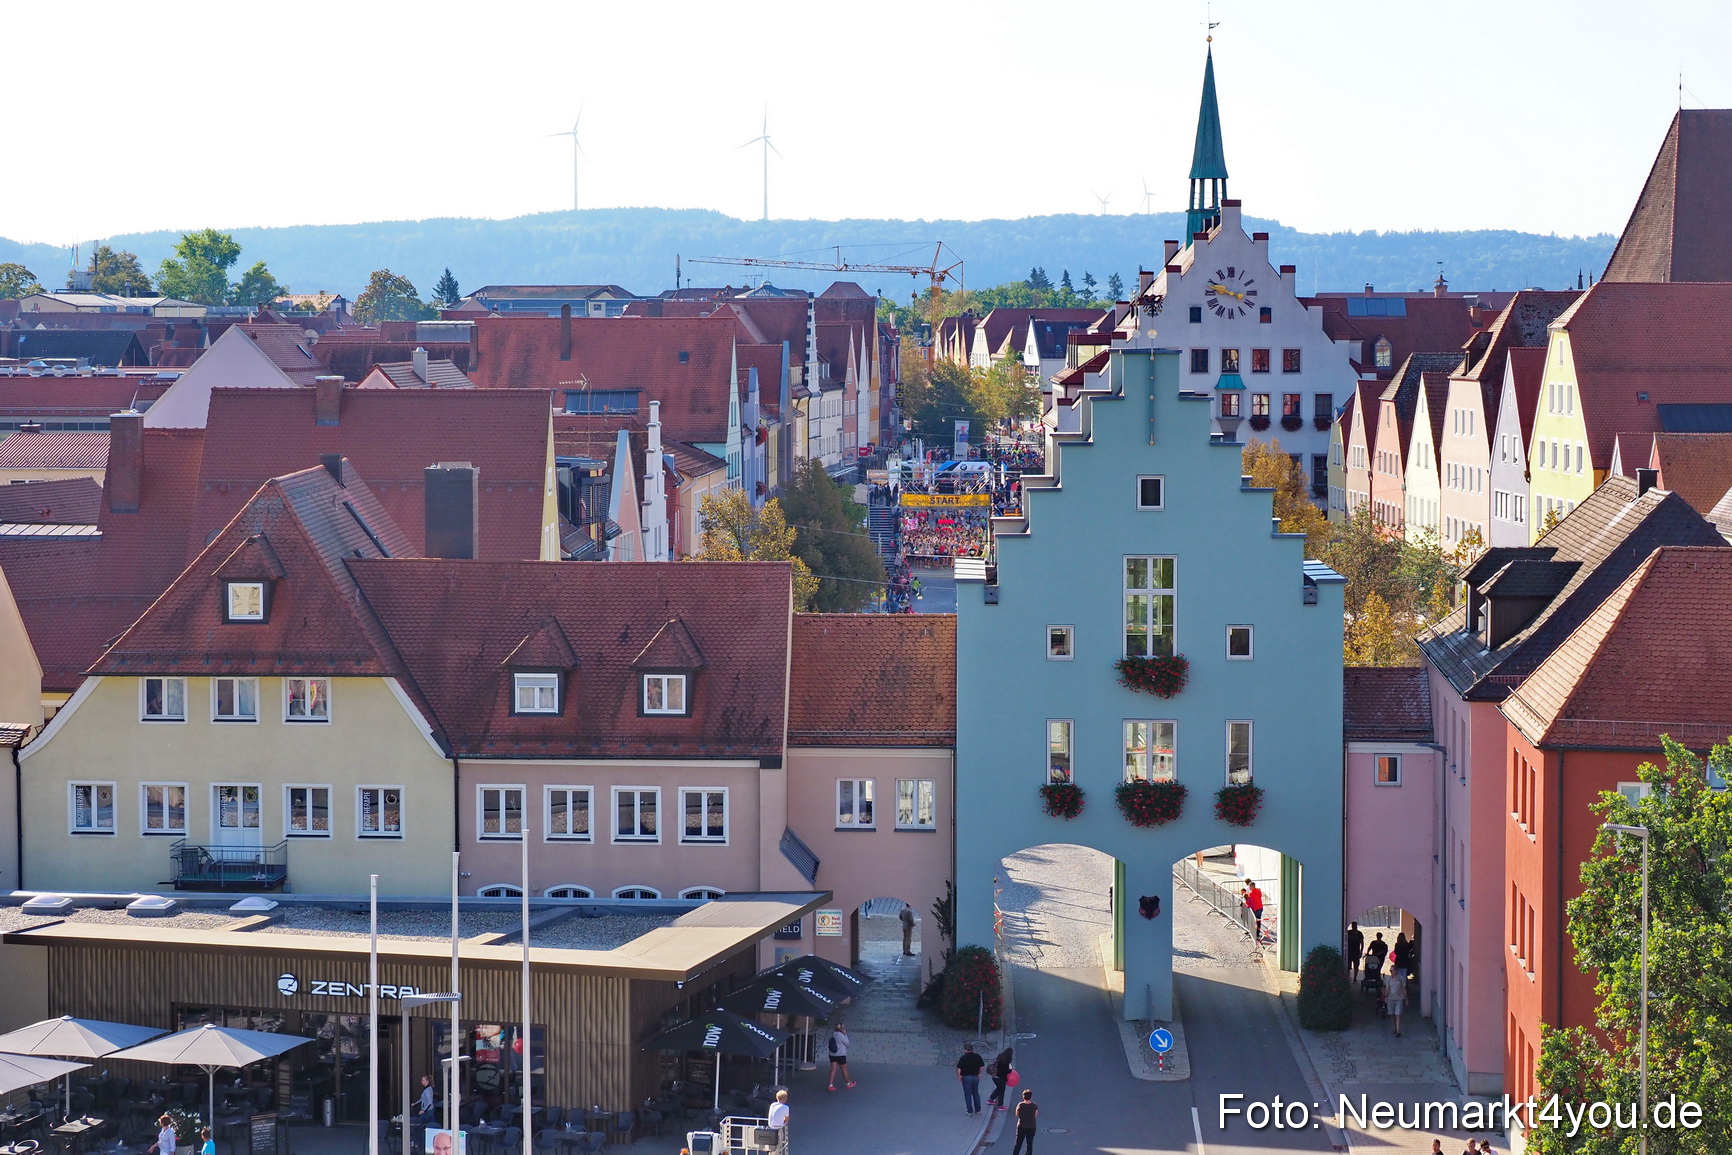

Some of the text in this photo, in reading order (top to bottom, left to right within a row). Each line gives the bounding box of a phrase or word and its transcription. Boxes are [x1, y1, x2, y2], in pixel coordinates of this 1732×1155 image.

[930, 496, 960, 505] START
[763, 990, 783, 1010] now
[702, 1025, 723, 1048] now
